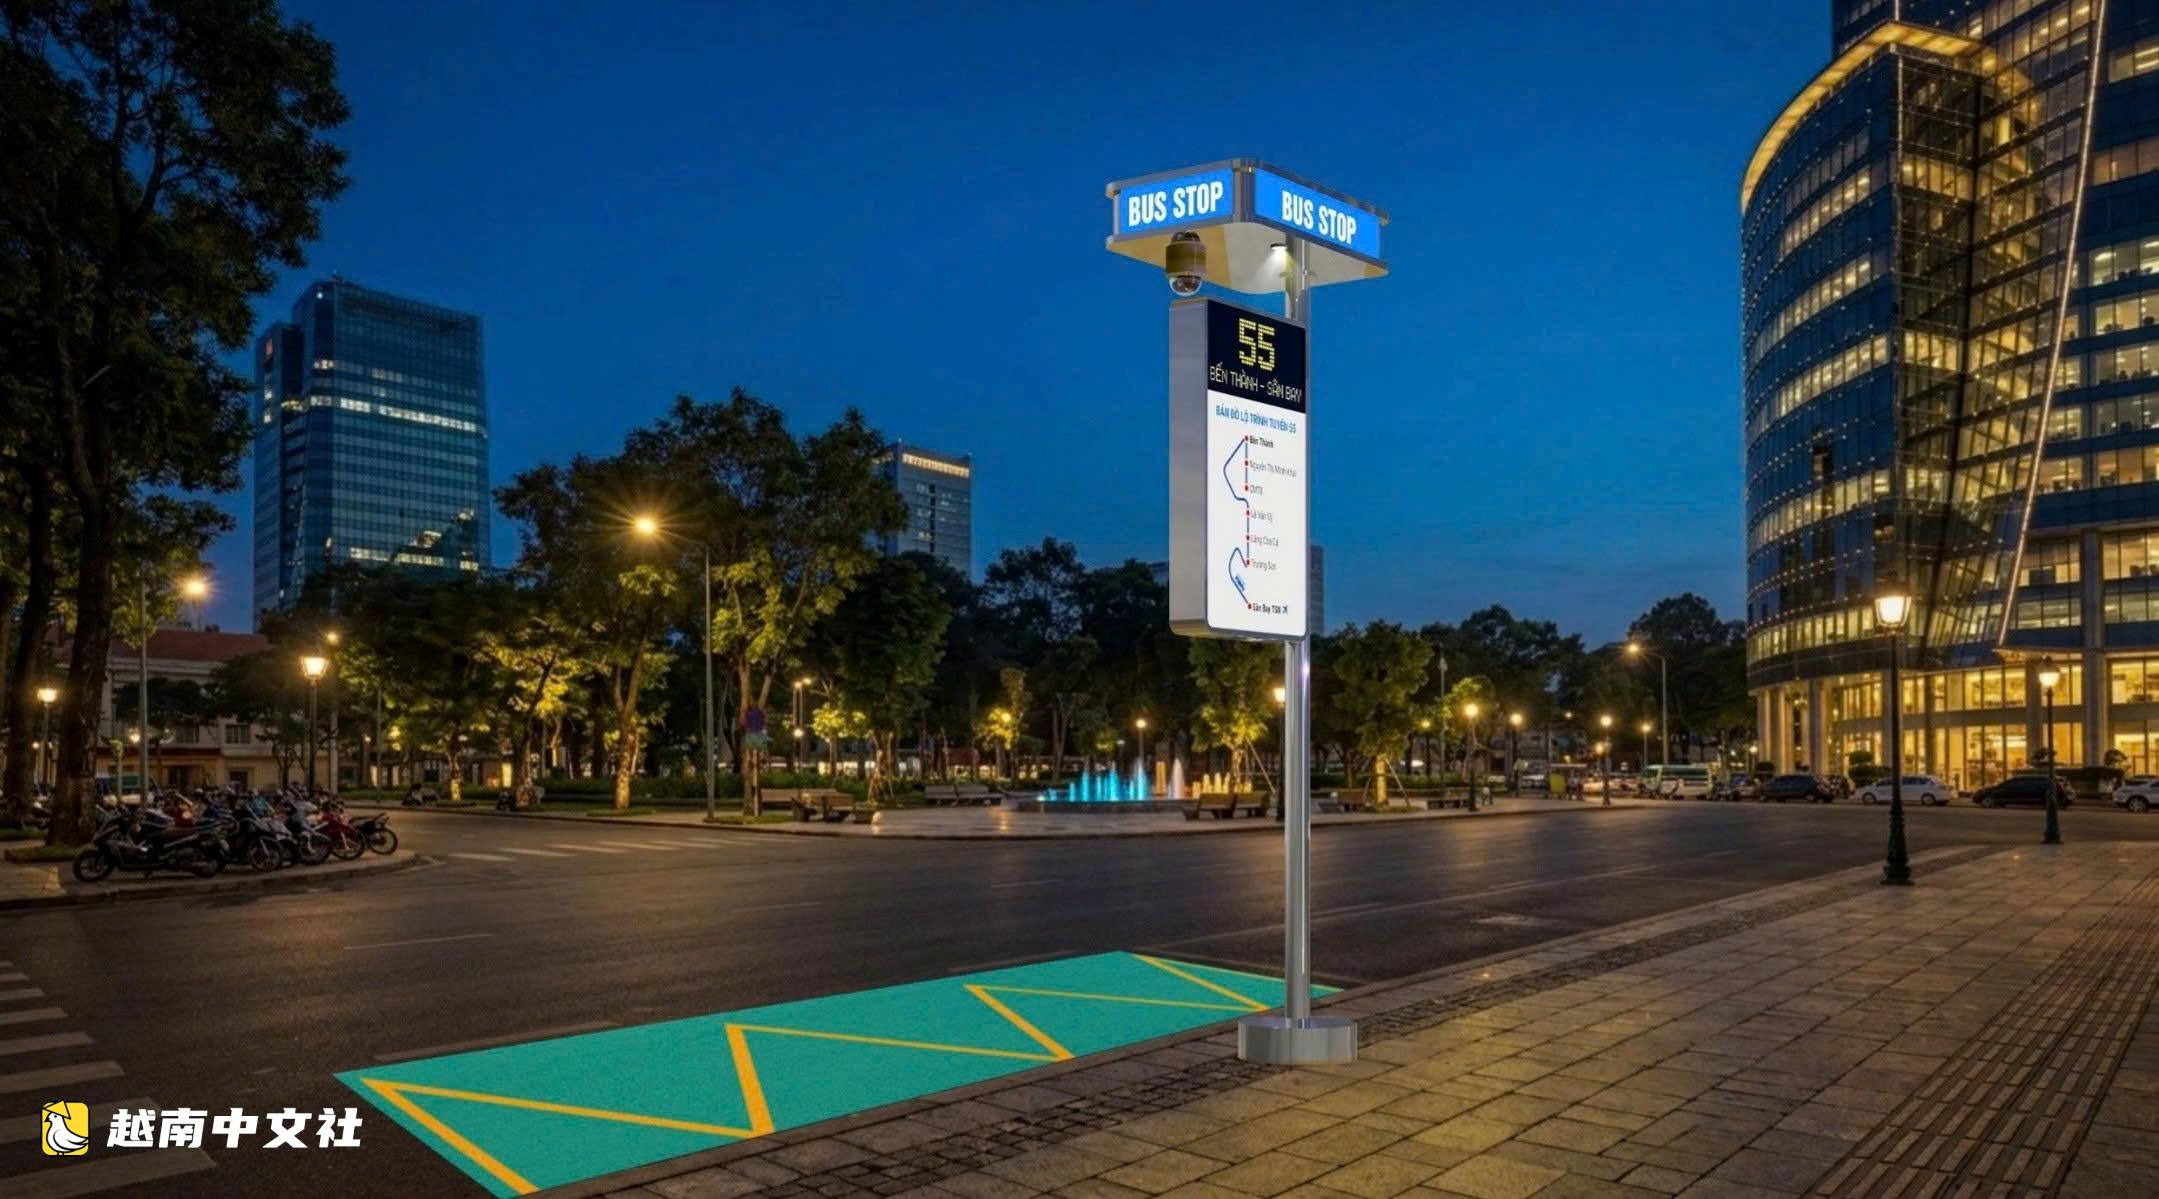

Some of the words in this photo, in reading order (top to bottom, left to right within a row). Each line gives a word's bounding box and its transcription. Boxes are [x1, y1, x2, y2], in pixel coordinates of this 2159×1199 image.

[1128, 190, 1167, 227] BUS
[1173, 180, 1224, 219] STOP
[1281, 190, 1314, 232] BUS
[1318, 204, 1357, 245] STOP
[1238, 317, 1276, 372] 55
[1209, 361, 1228, 384] BẾN
[1230, 368, 1259, 392] THÀNH
[1266, 378, 1284, 399] SÂN
[1285, 386, 1303, 403] BAY
